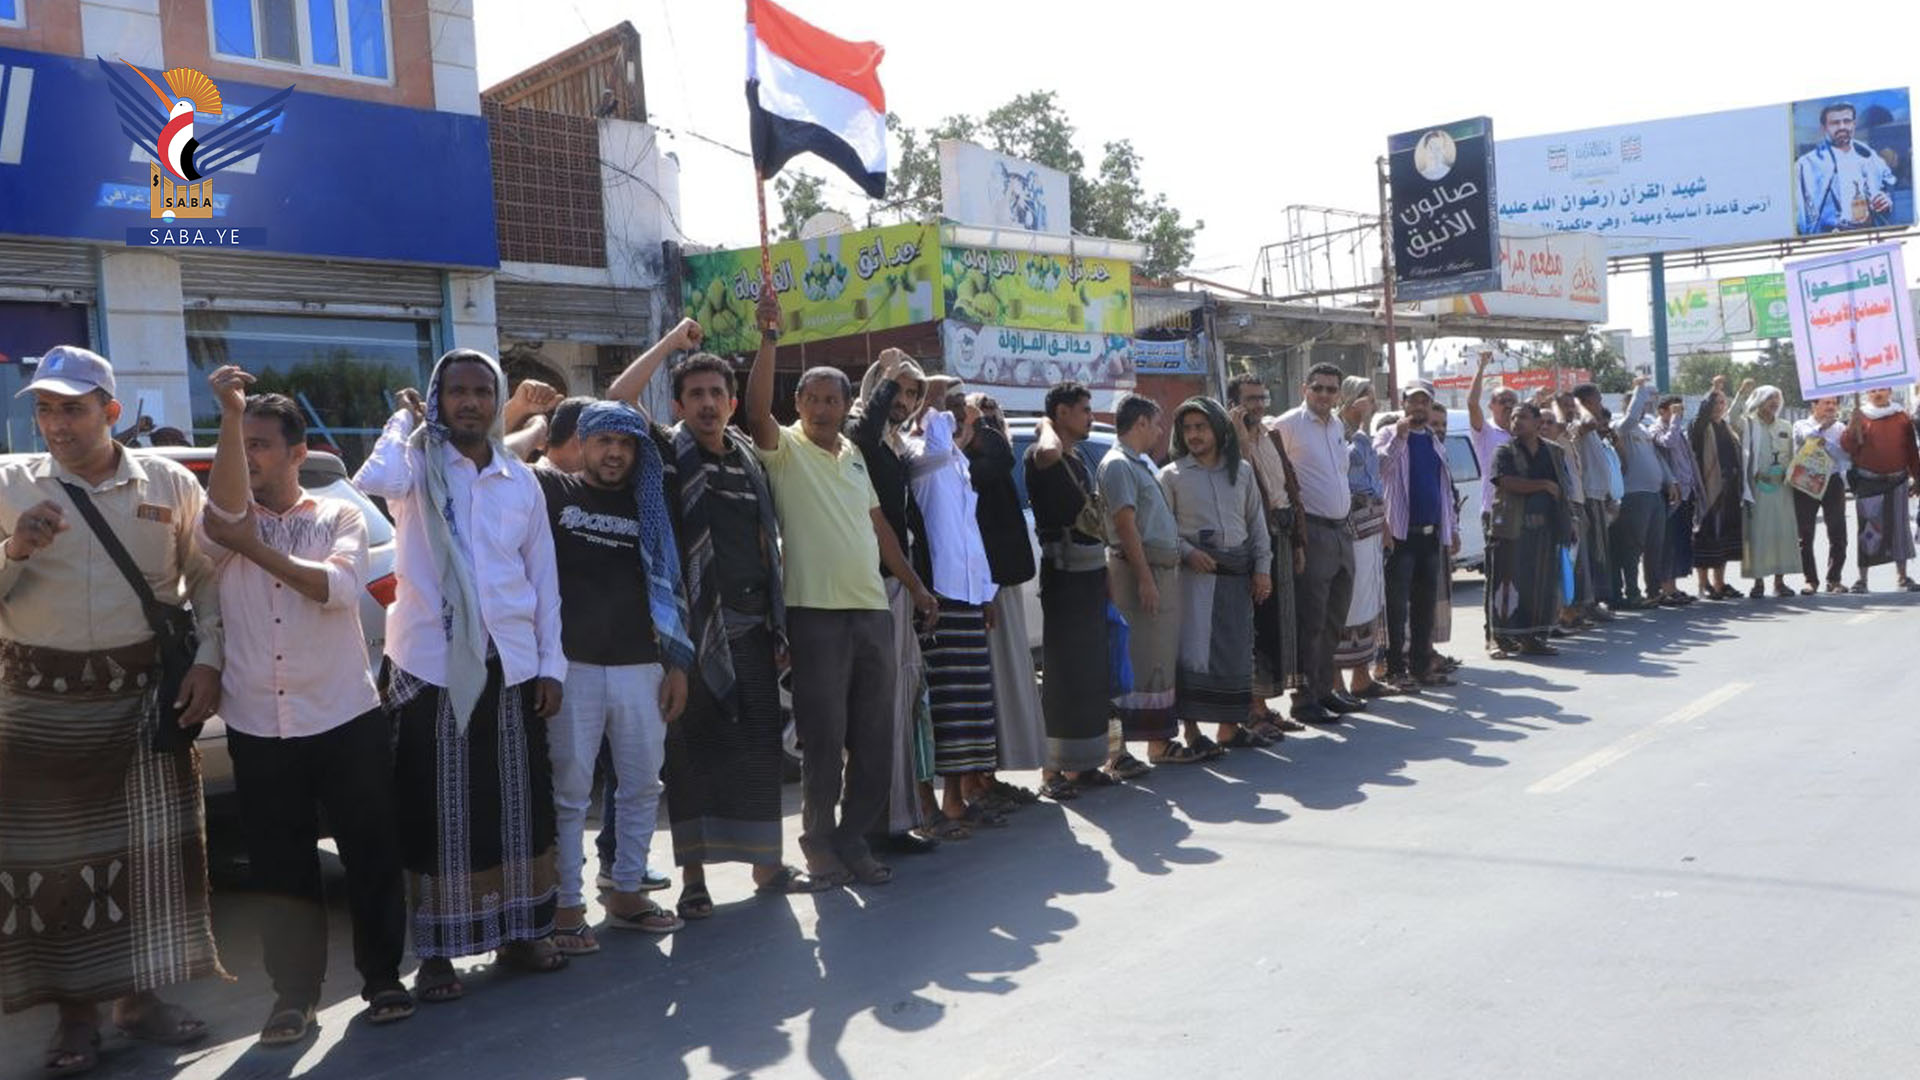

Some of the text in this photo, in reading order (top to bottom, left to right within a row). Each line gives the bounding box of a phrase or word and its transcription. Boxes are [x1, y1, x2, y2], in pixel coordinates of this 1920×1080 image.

[1620, 182, 1665, 205] القرآن
[1671, 176, 1707, 198] شهيد
[1400, 181, 1478, 225] صالون
[1532, 197, 1555, 211] الله
[1406, 208, 1476, 258] الأنيق
[857, 236, 921, 280] حدائق
[1804, 263, 1888, 303] قاطعوا
[1047, 334, 1091, 356] حدائق
